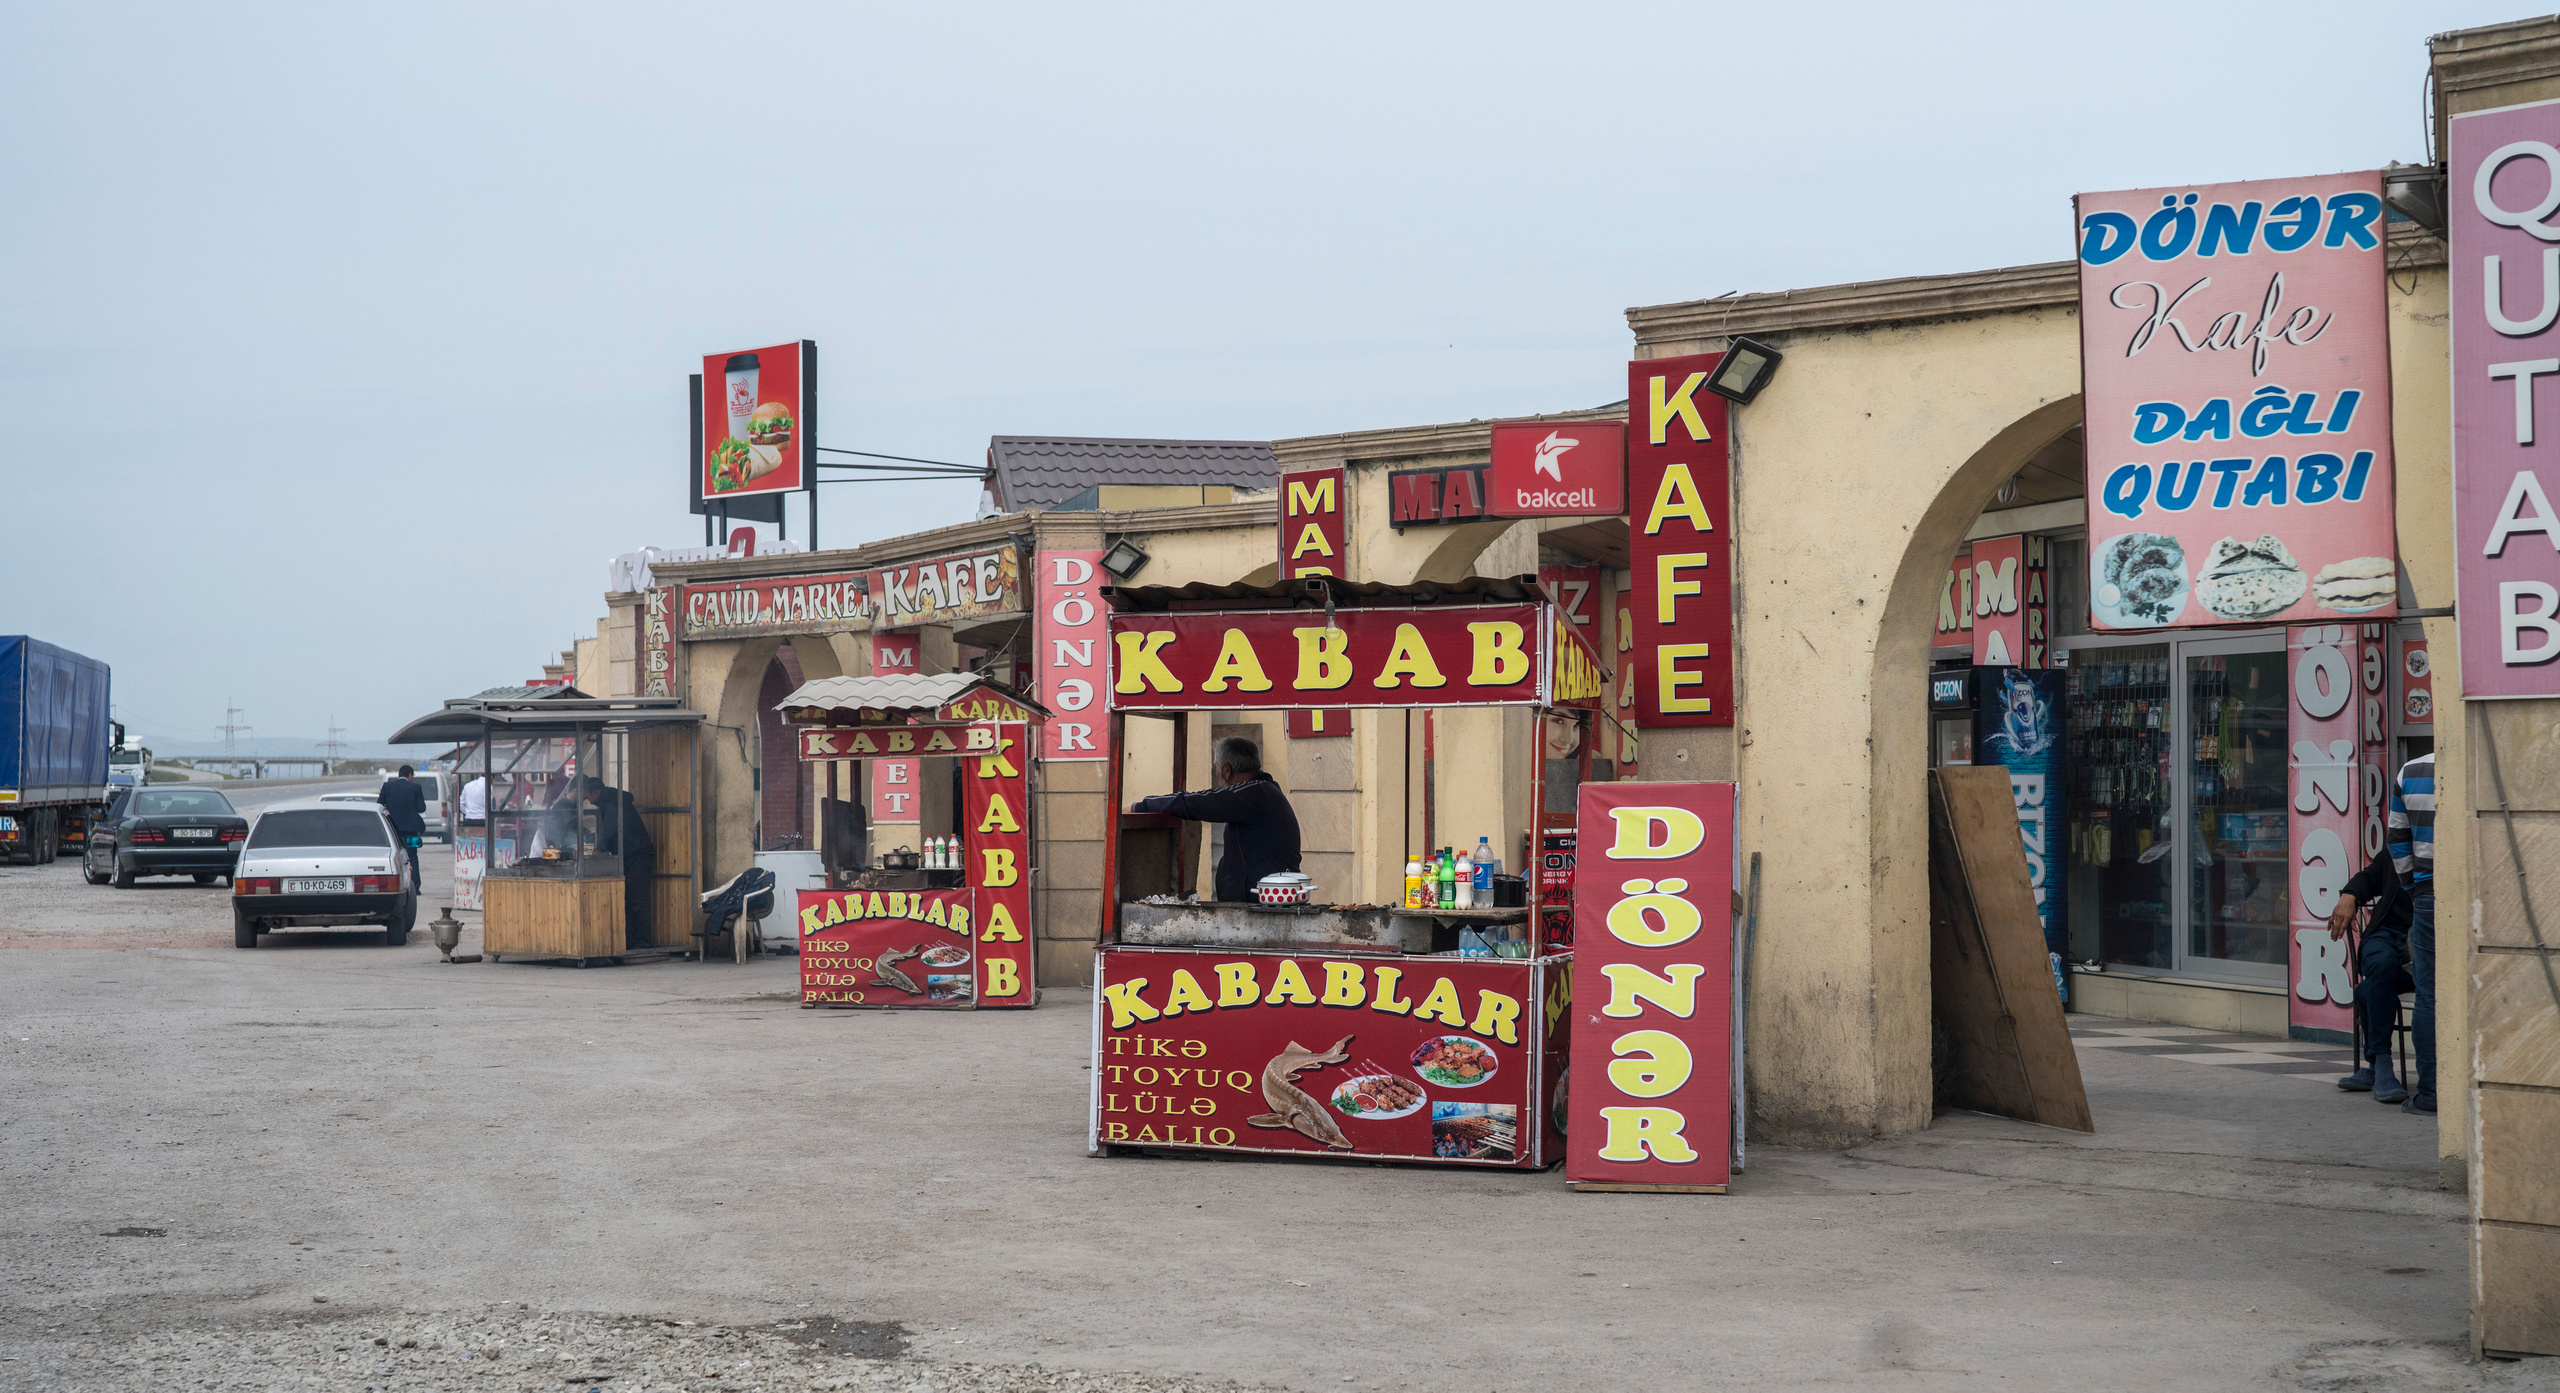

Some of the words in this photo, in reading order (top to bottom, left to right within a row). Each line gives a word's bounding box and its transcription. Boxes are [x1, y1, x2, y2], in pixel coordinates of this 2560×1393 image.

[2080, 191, 2384, 267] DÖNƏR
[2110, 271, 2335, 377] Kafe
[2473, 140, 2560, 664] QUTAB
[1517, 488, 1597, 508] bakcell
[2102, 450, 2376, 519] QUTABI
[1644, 372, 1713, 714] KAFE
[689, 583, 760, 628] CAVİD
[882, 550, 1003, 617] KAFE
[2028, 537, 2044, 669] MARK
[650, 592, 670, 697] KABA
[1052, 558, 1097, 751] DÖNƏR
[1115, 621, 1531, 695] KABAB
[1553, 619, 1601, 702] KABAB
[951, 699, 1030, 722] KABAB
[1934, 679, 1963, 702] BIZON
[807, 728, 994, 755] KABAB
[2292, 624, 2354, 1005] ÖNƏR
[977, 739, 1023, 997] KABAB
[800, 892, 970, 936] KABABLAR
[804, 938, 850, 952] TİKƏ
[804, 957, 873, 971] TOYUQ
[804, 973, 856, 987] LÜLƏ
[804, 990, 865, 1004] BALIQ
[1598, 806, 1705, 1163] DÖNƏR
[1104, 959, 1522, 1045] KABABLAR
[1106, 1065, 1253, 1094] TOYUQ
[1107, 1034, 1208, 1059] TİKƏ
[1105, 1091, 1217, 1117] LÜLƏ
